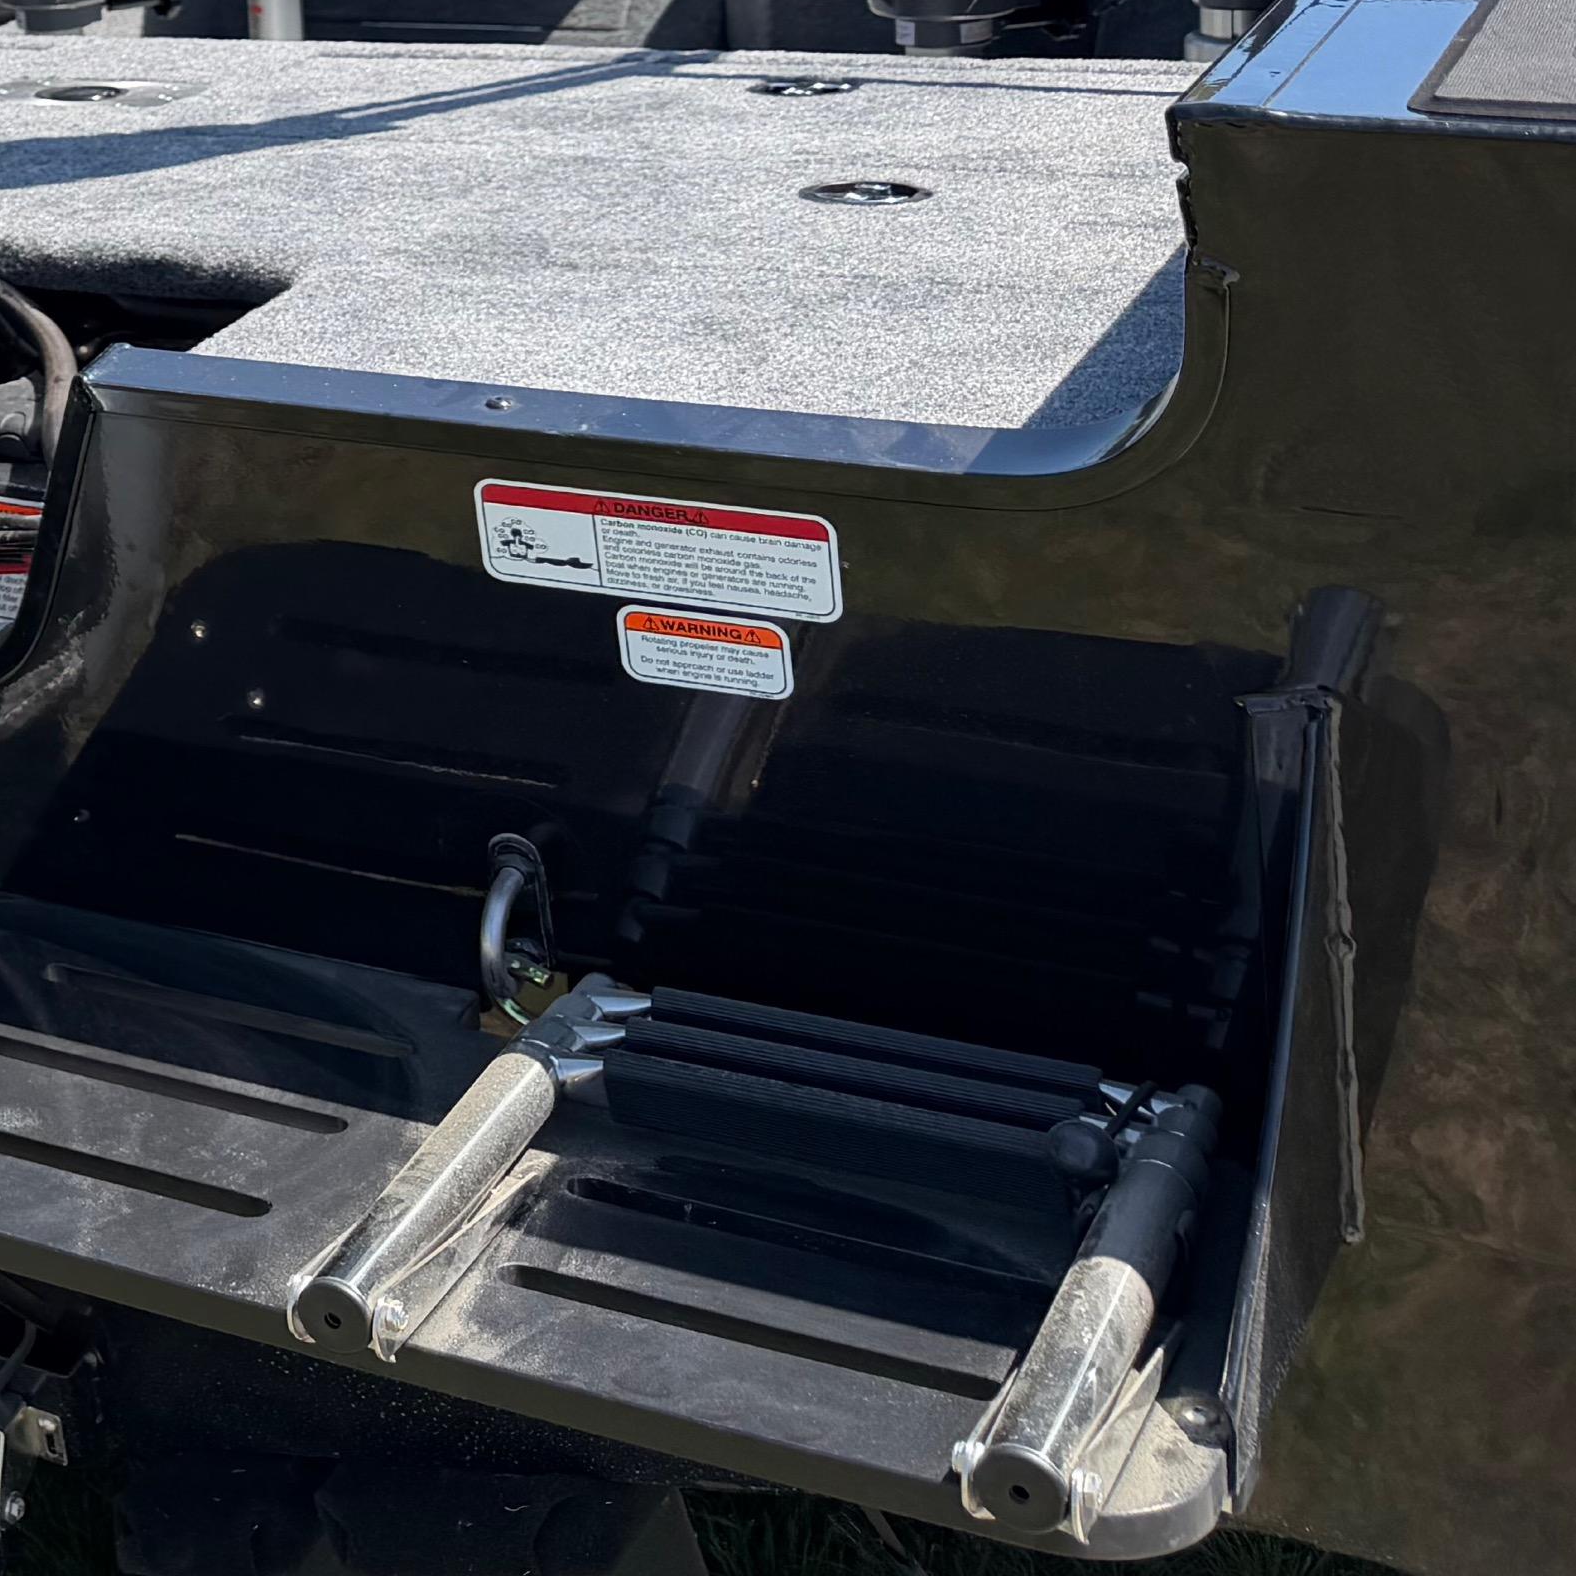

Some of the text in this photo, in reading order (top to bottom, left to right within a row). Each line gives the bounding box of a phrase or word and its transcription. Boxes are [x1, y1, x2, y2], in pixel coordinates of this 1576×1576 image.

[613, 502, 688, 521] DANGER
[686, 528, 707, 539] (CO)
[660, 619, 742, 640] WARNING
[641, 655, 653, 664] Do
